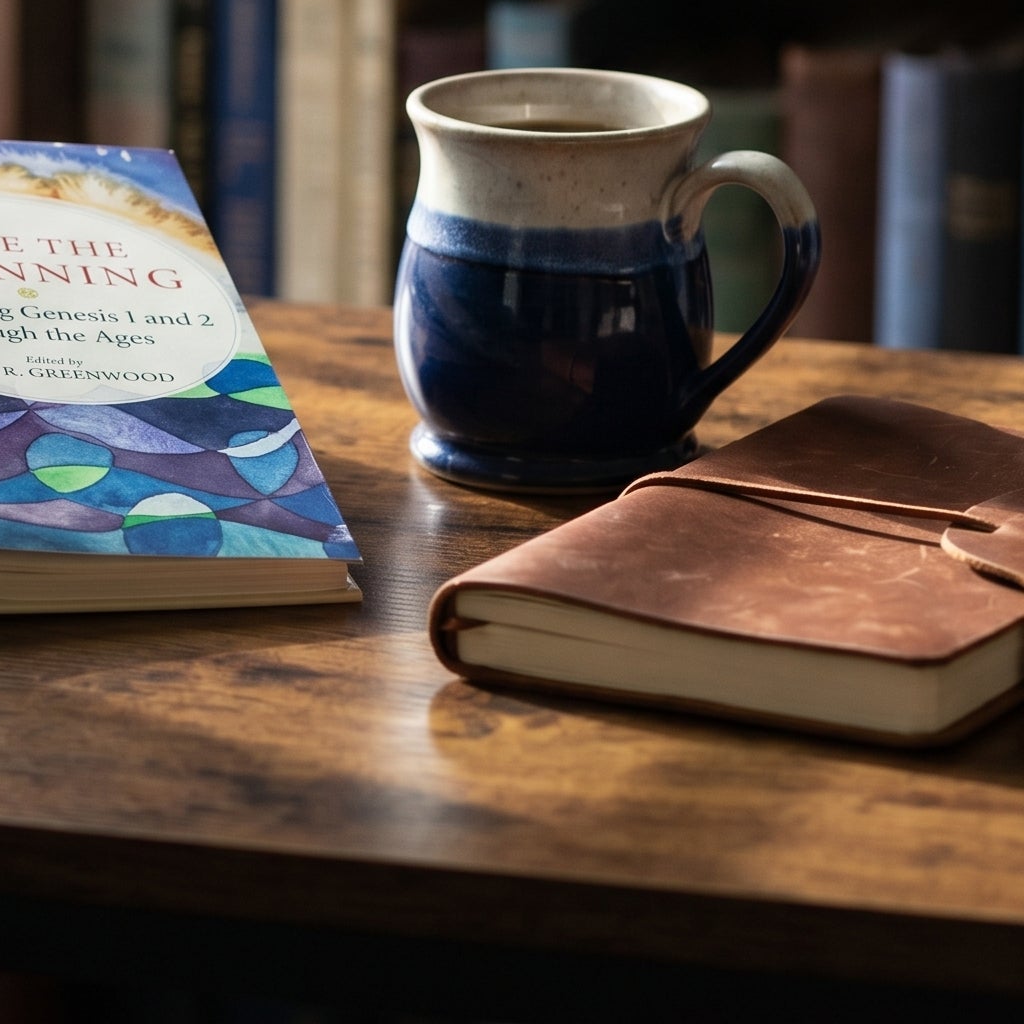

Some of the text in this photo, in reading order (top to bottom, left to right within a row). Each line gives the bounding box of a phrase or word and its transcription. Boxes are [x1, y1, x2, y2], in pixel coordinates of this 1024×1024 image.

[36, 238, 128, 258] THE
[20, 305, 120, 323] Genesis
[144, 312, 193, 327] and
[196, 314, 215, 327] 2
[45, 327, 87, 343] the
[95, 329, 156, 349] Ages
[26, 355, 84, 368] Edited by
[2, 366, 24, 377] R.
[28, 367, 175, 383] GREENWOOD
